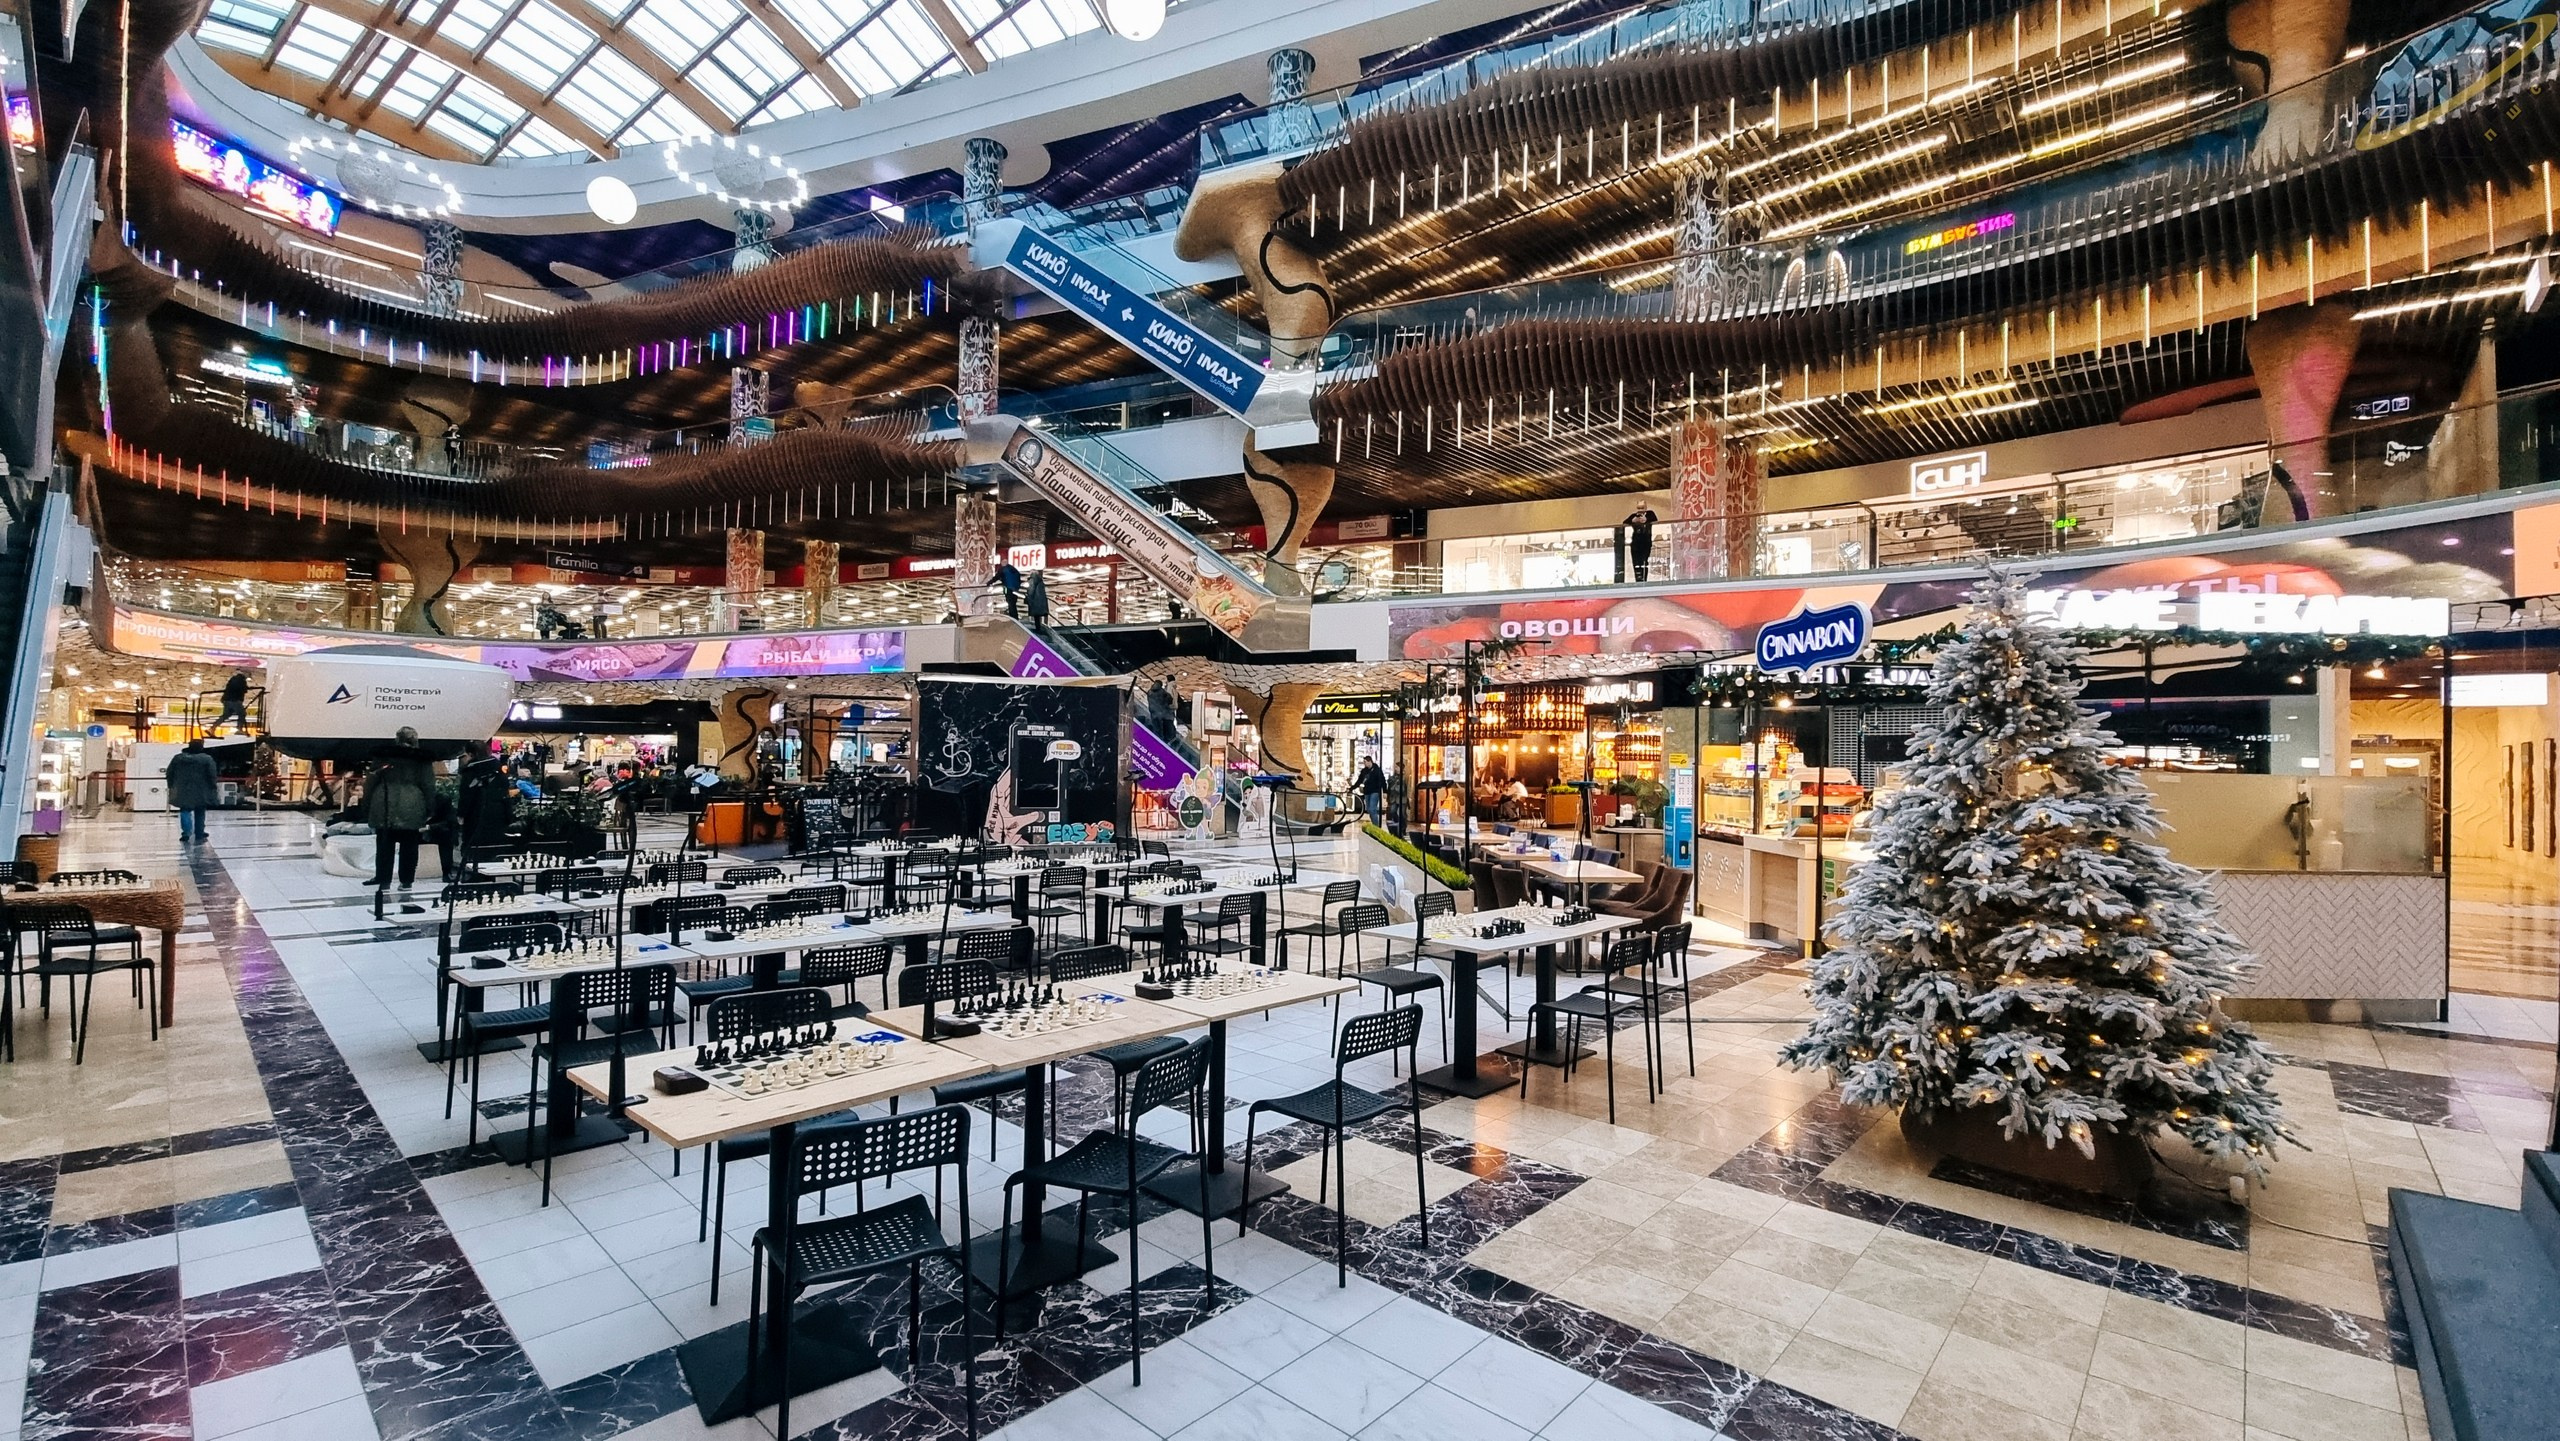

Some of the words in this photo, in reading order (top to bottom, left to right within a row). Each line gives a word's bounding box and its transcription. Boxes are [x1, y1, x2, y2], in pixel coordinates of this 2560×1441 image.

[1070, 273, 1112, 306] IMAX
[1196, 352, 1243, 389] IMAX
[1209, 375, 1237, 396] SAPPHIRE
[1040, 467, 1091, 515] Папаша
[1091, 505, 1137, 549] Клаусс
[1049, 455, 1094, 494] Огромный
[1092, 485, 1125, 518] пивной
[1122, 511, 1168, 550] ресторан
[1012, 548, 1042, 567] Hoff
[1055, 546, 1097, 560] ТОВАРЫ
[307, 564, 335, 579] Hoff
[1161, 553, 1169, 564] 4
[1165, 562, 1195, 586] этаж
[1500, 616, 1635, 639] ОВОЩИ
[1761, 616, 1856, 663] CINNABON
[576, 658, 620, 671] МЯСО
[762, 650, 814, 664] РЫБА
[818, 649, 831, 662] И
[835, 646, 887, 661] ИКРА
[375, 686, 441, 696] ПОЧУВСТВУЙ
[374, 703, 426, 711] ПИЛОТОМ
